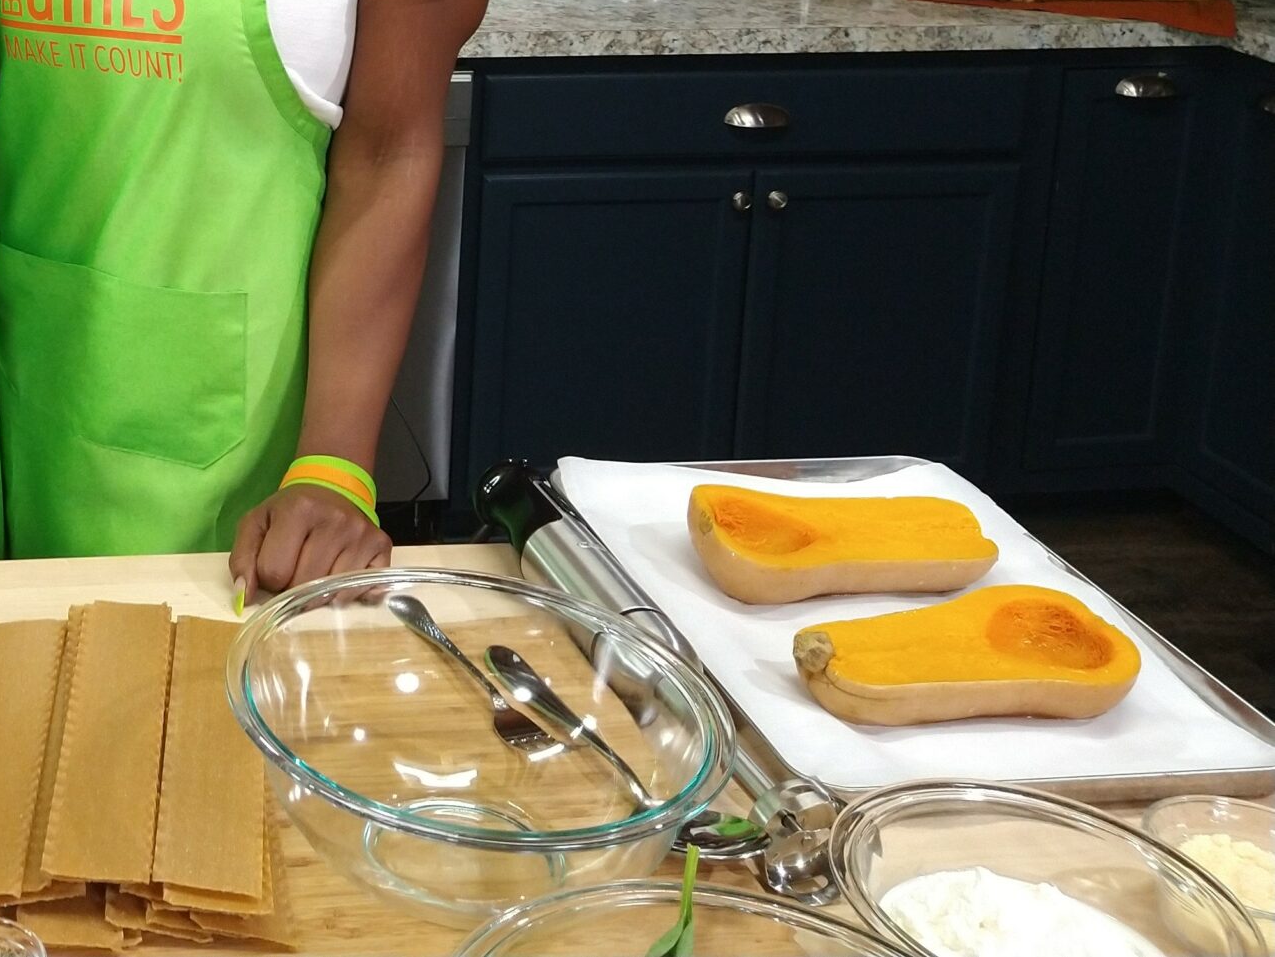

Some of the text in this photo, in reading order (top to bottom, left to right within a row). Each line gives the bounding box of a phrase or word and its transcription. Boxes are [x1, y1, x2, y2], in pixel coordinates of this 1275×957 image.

[4, 34, 184, 83] MAKE IT COUNT!
